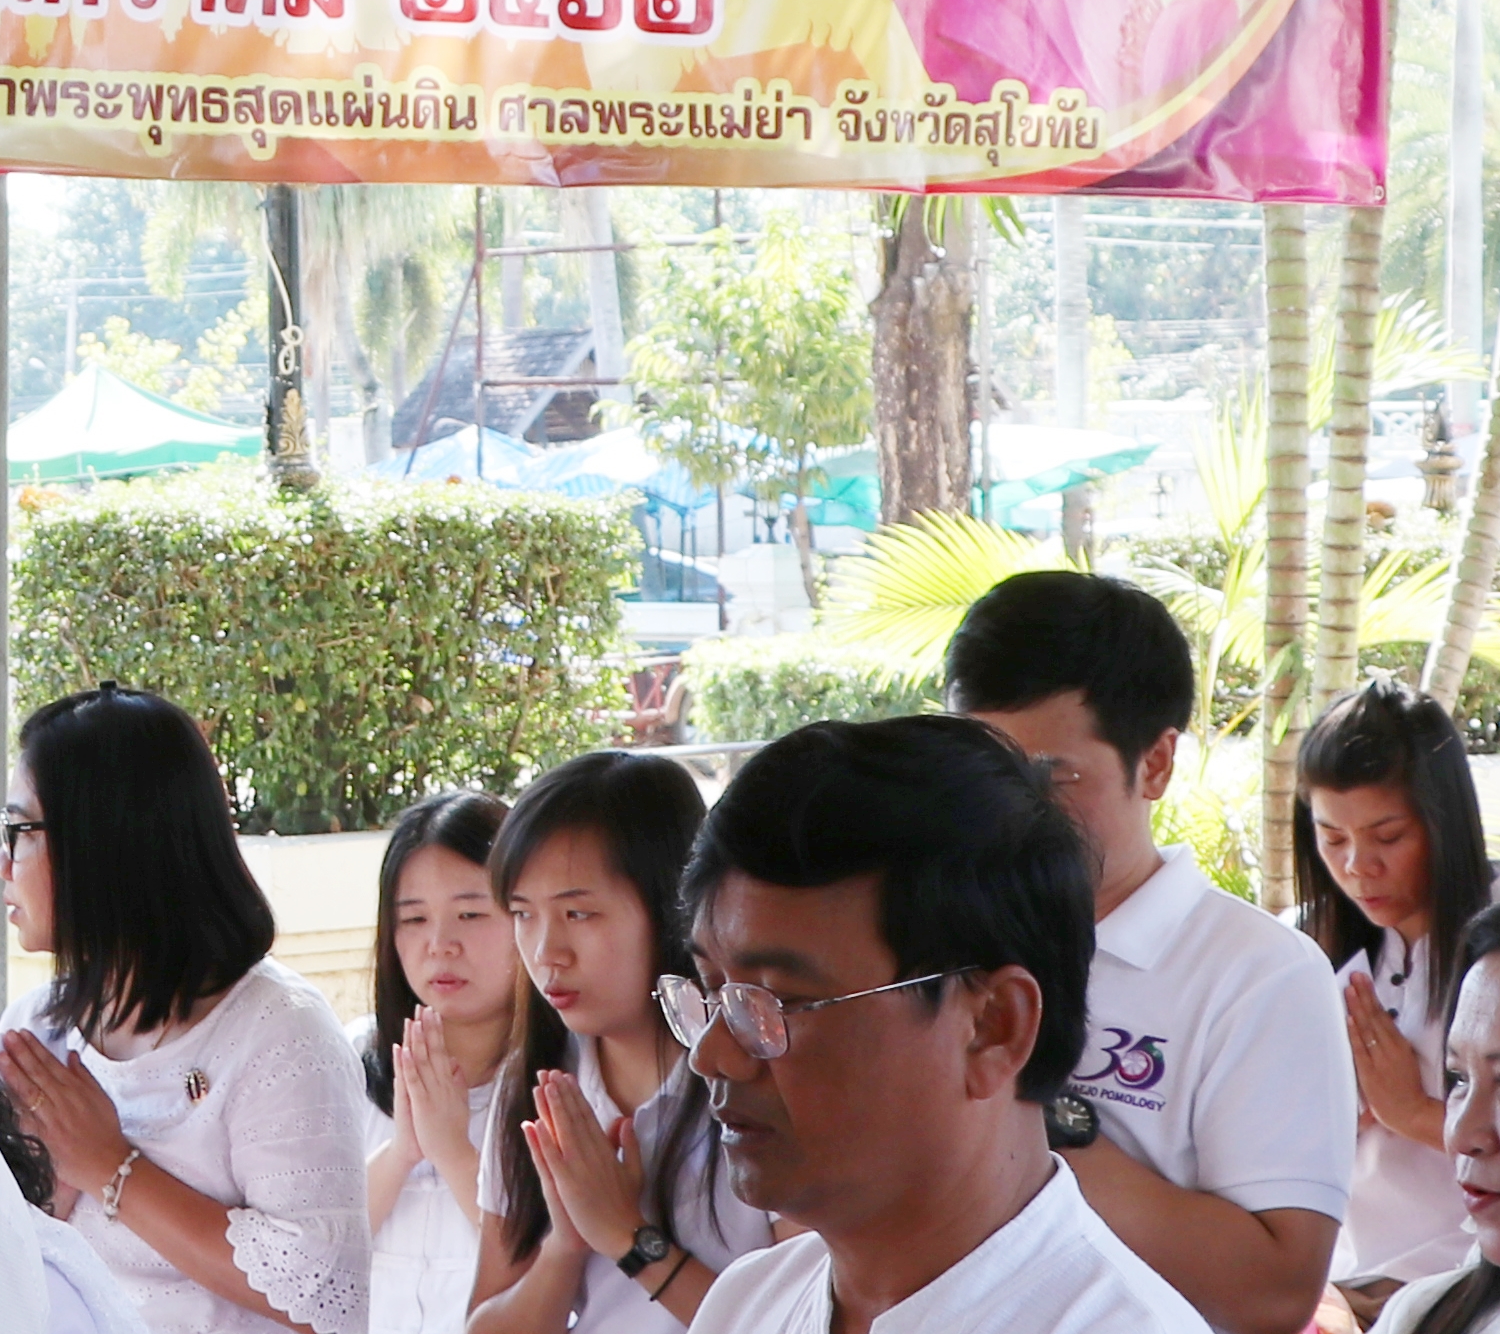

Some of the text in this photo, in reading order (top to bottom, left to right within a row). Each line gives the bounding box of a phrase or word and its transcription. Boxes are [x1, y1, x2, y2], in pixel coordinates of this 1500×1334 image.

[499, 88, 813, 141] ศาลพระแม่ย่า
[837, 88, 1099, 167] จังหวัดสุโขทัย
[1071, 1027, 1168, 1092] 35
[1068, 1084, 1167, 1111] AEJO POMOLOGY
